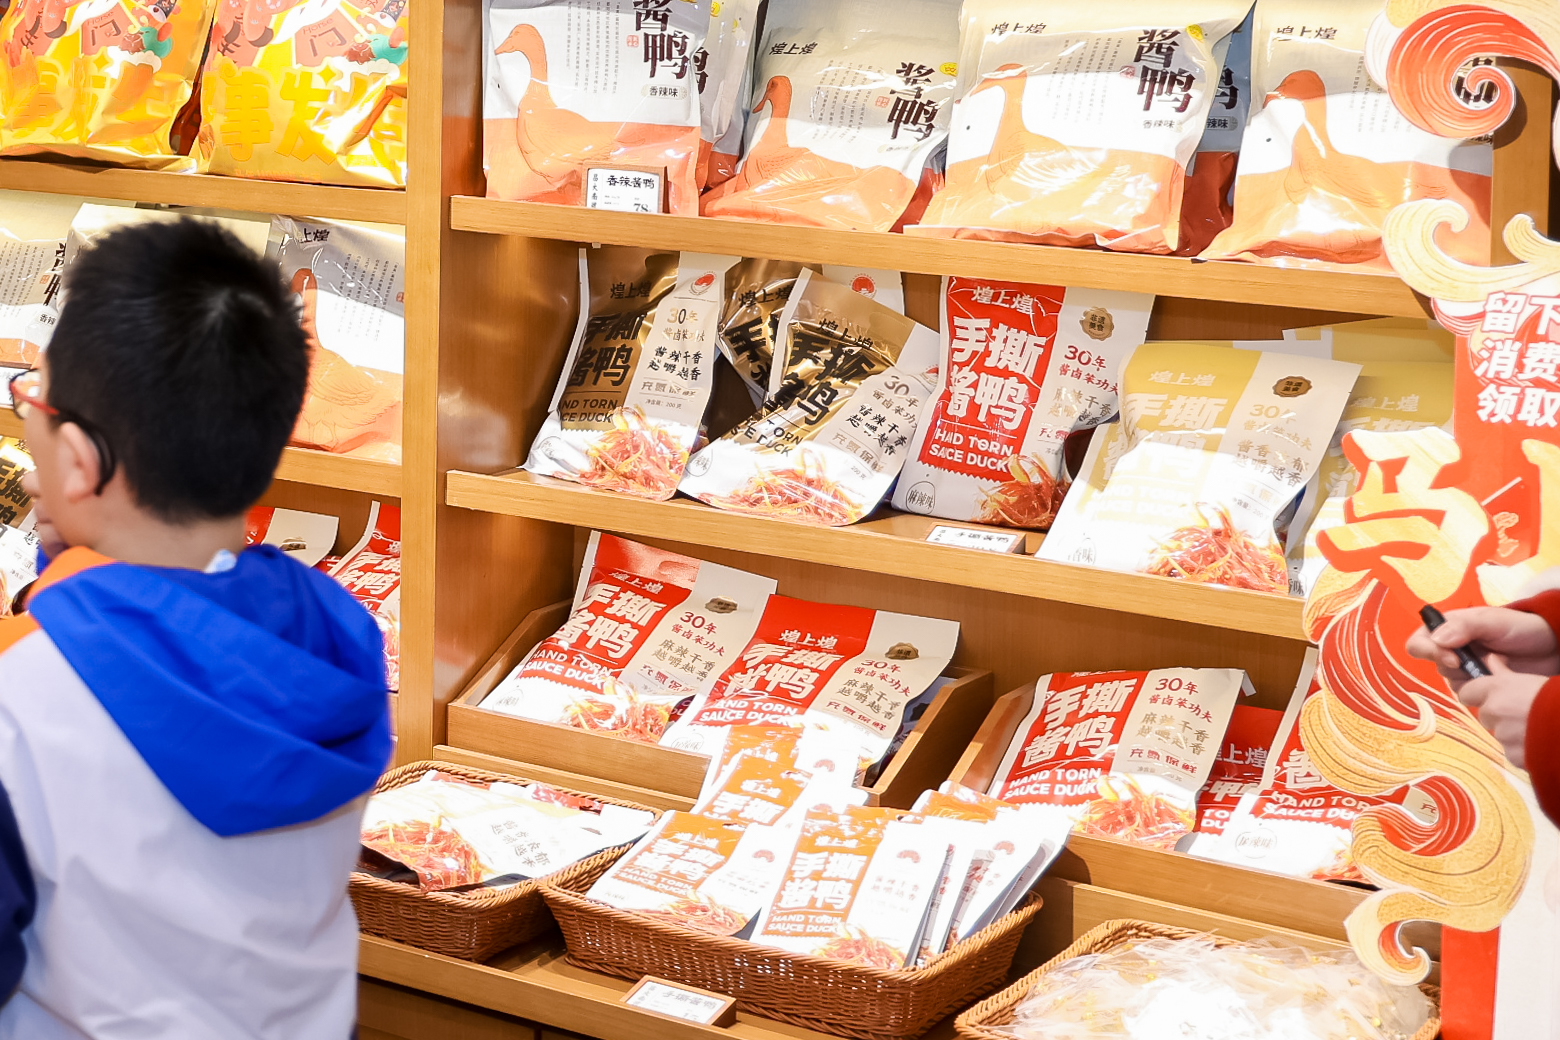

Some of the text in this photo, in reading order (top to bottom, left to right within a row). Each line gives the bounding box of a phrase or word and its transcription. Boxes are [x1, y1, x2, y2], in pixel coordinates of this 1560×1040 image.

[769, 41, 818, 55] 煌上煌
[1133, 29, 1195, 113] 酱鸭
[649, 86, 679, 98] 香辣味
[887, 62, 940, 142] 酱鸭
[1142, 118, 1175, 130] 香辣味
[607, 175, 655, 189] 香辣酱鸭
[610, 281, 652, 300] 煌上煌
[971, 285, 1035, 315] 煌上煌
[950, 316, 1048, 380] 手撕
[1064, 345, 1107, 372] 30年
[1474, 339, 1560, 382] 消费
[1148, 370, 1217, 387] 煌上煌
[583, 399, 618, 409] TORN
[947, 364, 1029, 431] 酱鸭
[1477, 385, 1560, 428] 领取
[1127, 394, 1229, 431] 手撕
[968, 435, 1014, 457] TORN
[966, 453, 1009, 474] DUCK
[907, 489, 935, 510] 麻辣味
[607, 568, 664, 595] 煌上煌
[583, 582, 669, 627] 手撕
[557, 610, 639, 660] 酱鸭
[680, 611, 717, 635] 30年
[671, 623, 725, 657] 酱卤笨功夫
[779, 628, 838, 650] 煌上煌
[572, 652, 612, 678] TORN
[659, 639, 716, 672] 麻辣干香
[742, 642, 845, 672] 手撕
[861, 660, 901, 673] 30年
[523, 660, 605, 689] SAUCE DUCK
[854, 667, 911, 697] 酱卤笨功夫
[1155, 677, 1199, 696] 30年
[699, 710, 743, 723] SAUCE
[753, 701, 798, 717] TORN
[1045, 678, 1138, 730] 手撕
[1149, 694, 1213, 724] 酱卤笨功夫
[1141, 712, 1210, 743] 麻辣干香
[1024, 715, 1113, 768] 酱鸭
[1130, 748, 1198, 774] 充氮保鲜
[1008, 767, 1102, 789] HAND TORN
[1004, 783, 1052, 801] SAUCE
[652, 837, 727, 867] 手撕
[624, 867, 693, 891] HAND TORN
[790, 850, 868, 882] 手撕
[778, 877, 854, 911] 酱鸭
[768, 922, 841, 934] SAUCE DUCK
[771, 914, 842, 925] HAND TORN
